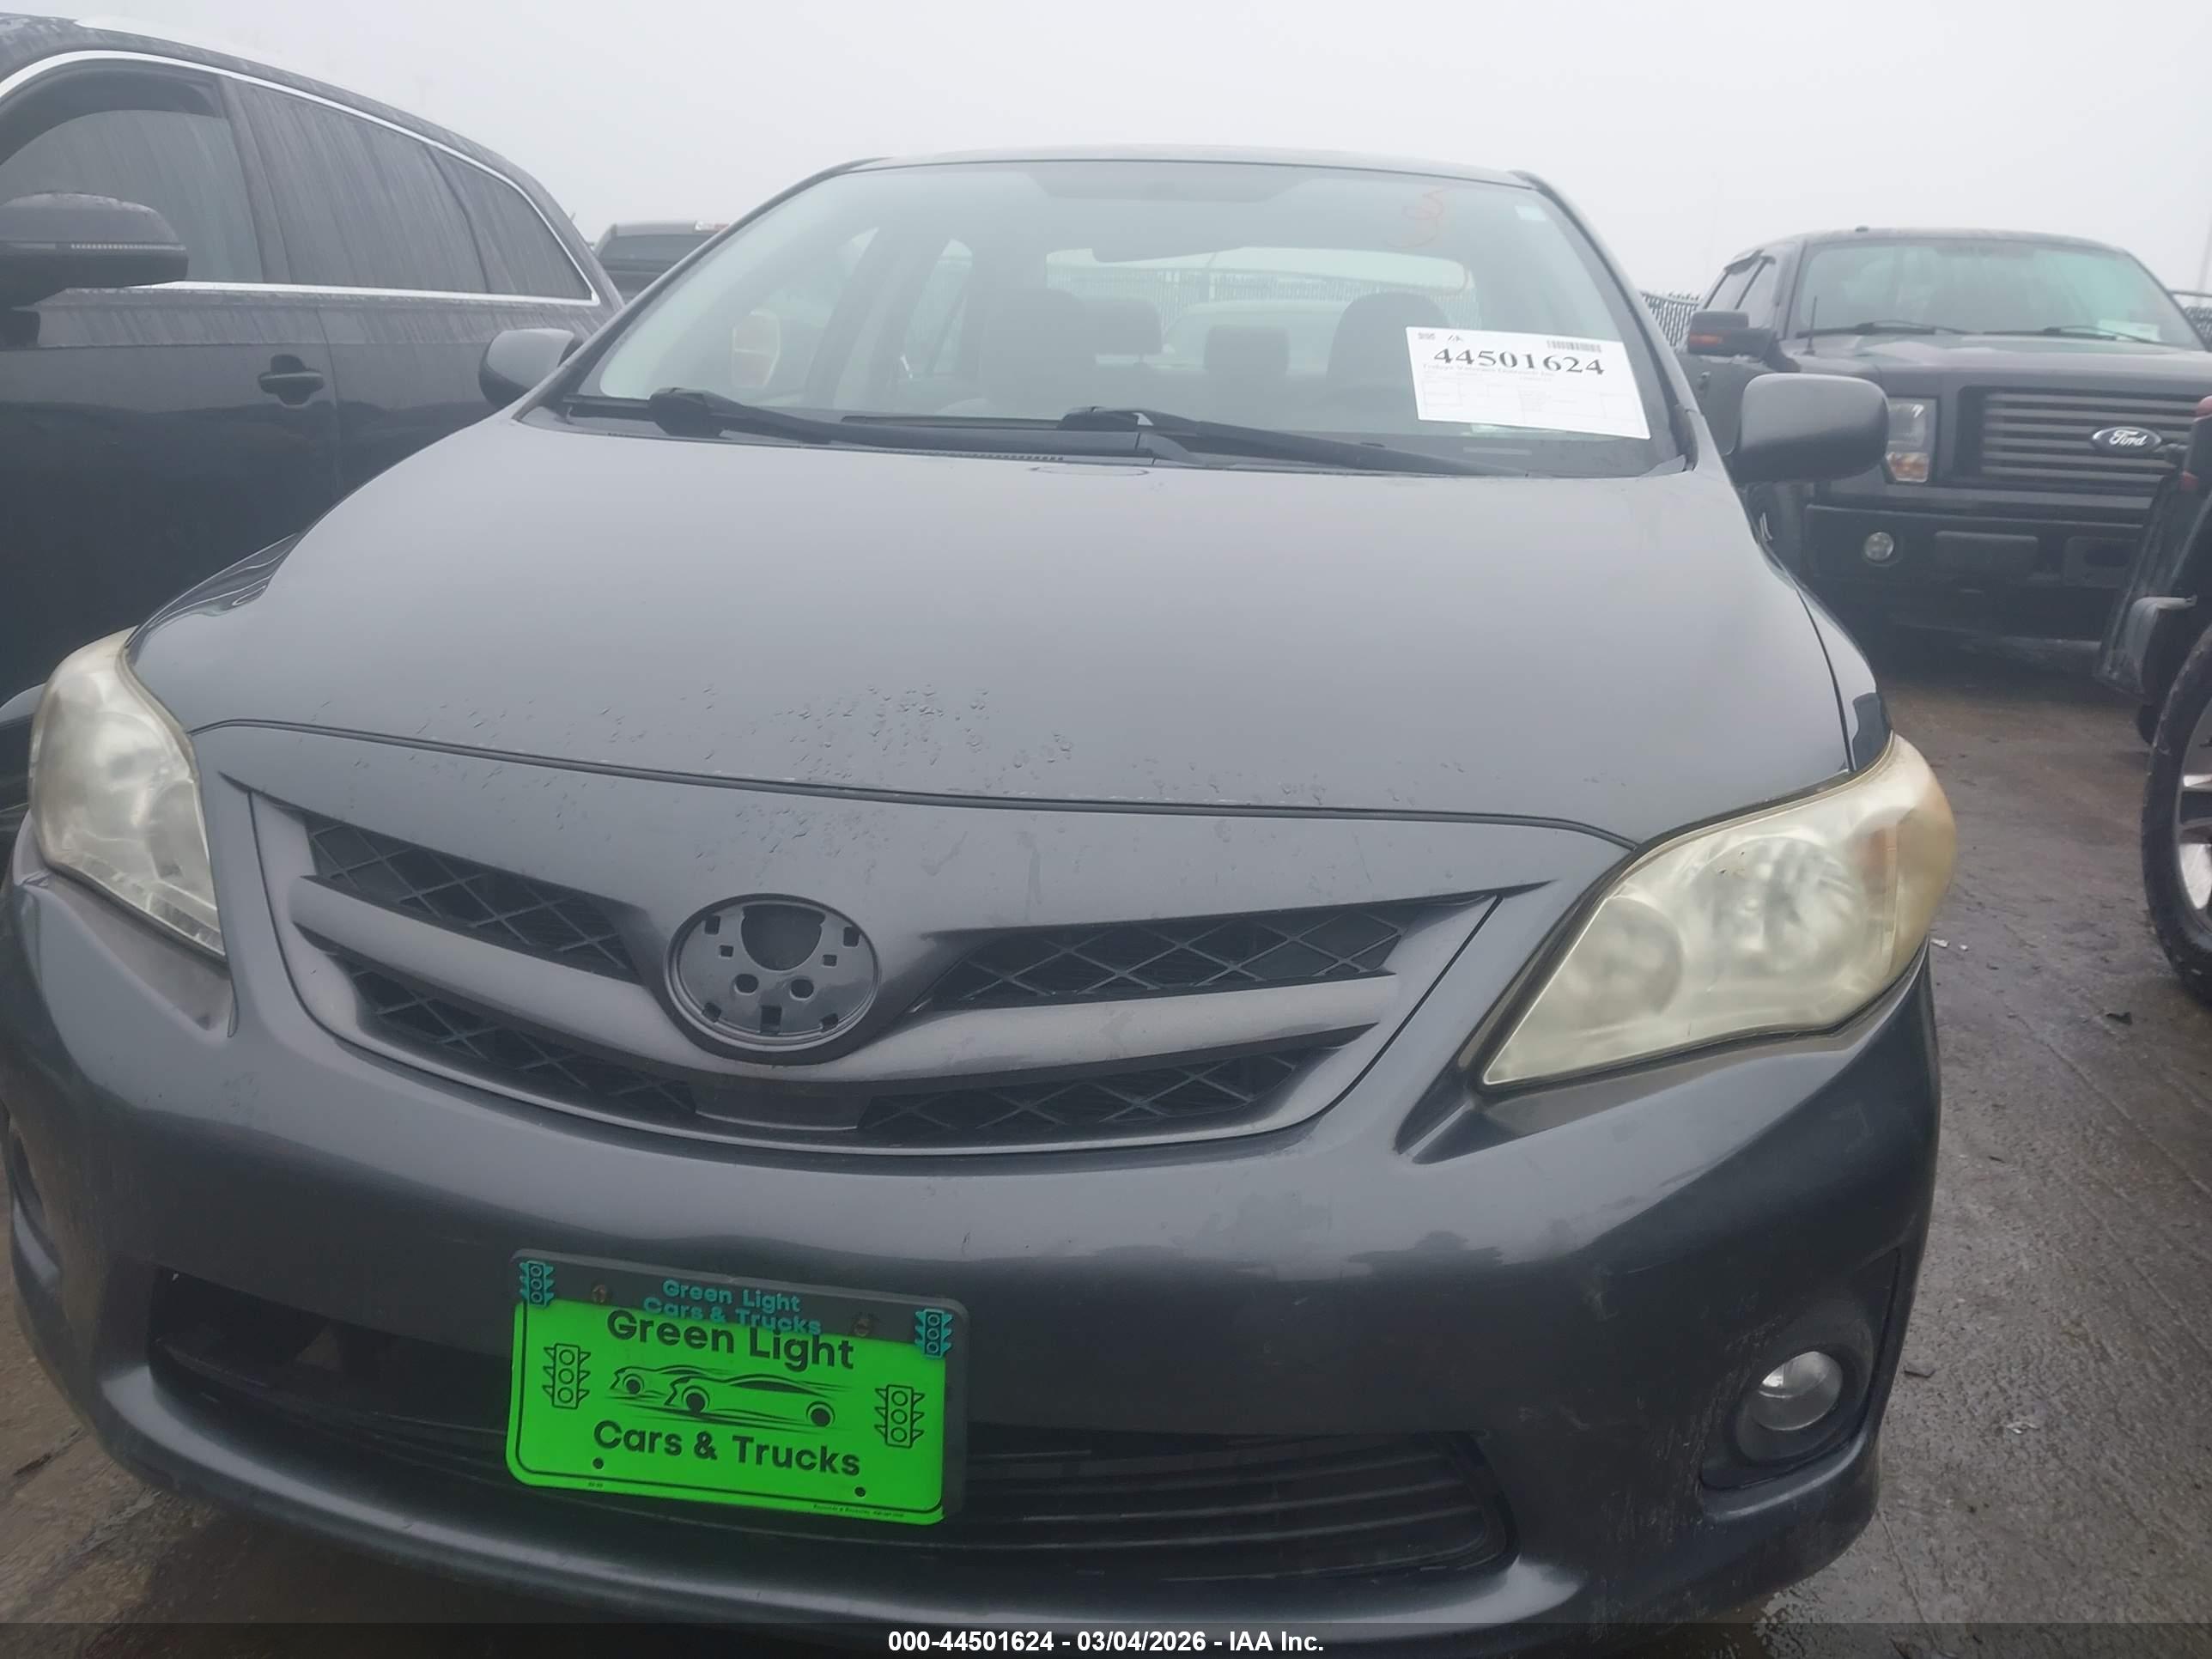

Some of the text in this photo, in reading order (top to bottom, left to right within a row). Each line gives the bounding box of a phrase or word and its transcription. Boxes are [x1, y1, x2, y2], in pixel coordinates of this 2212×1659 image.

[1433, 348, 1605, 375] 44501624
[2109, 429, 2148, 447] Ford
[663, 1279, 802, 1313] Green Light
[643, 1297, 822, 1334] Cars & Trucks
[606, 1310, 855, 1372] Green Light
[593, 1419, 861, 1476] Cars & Trucks
